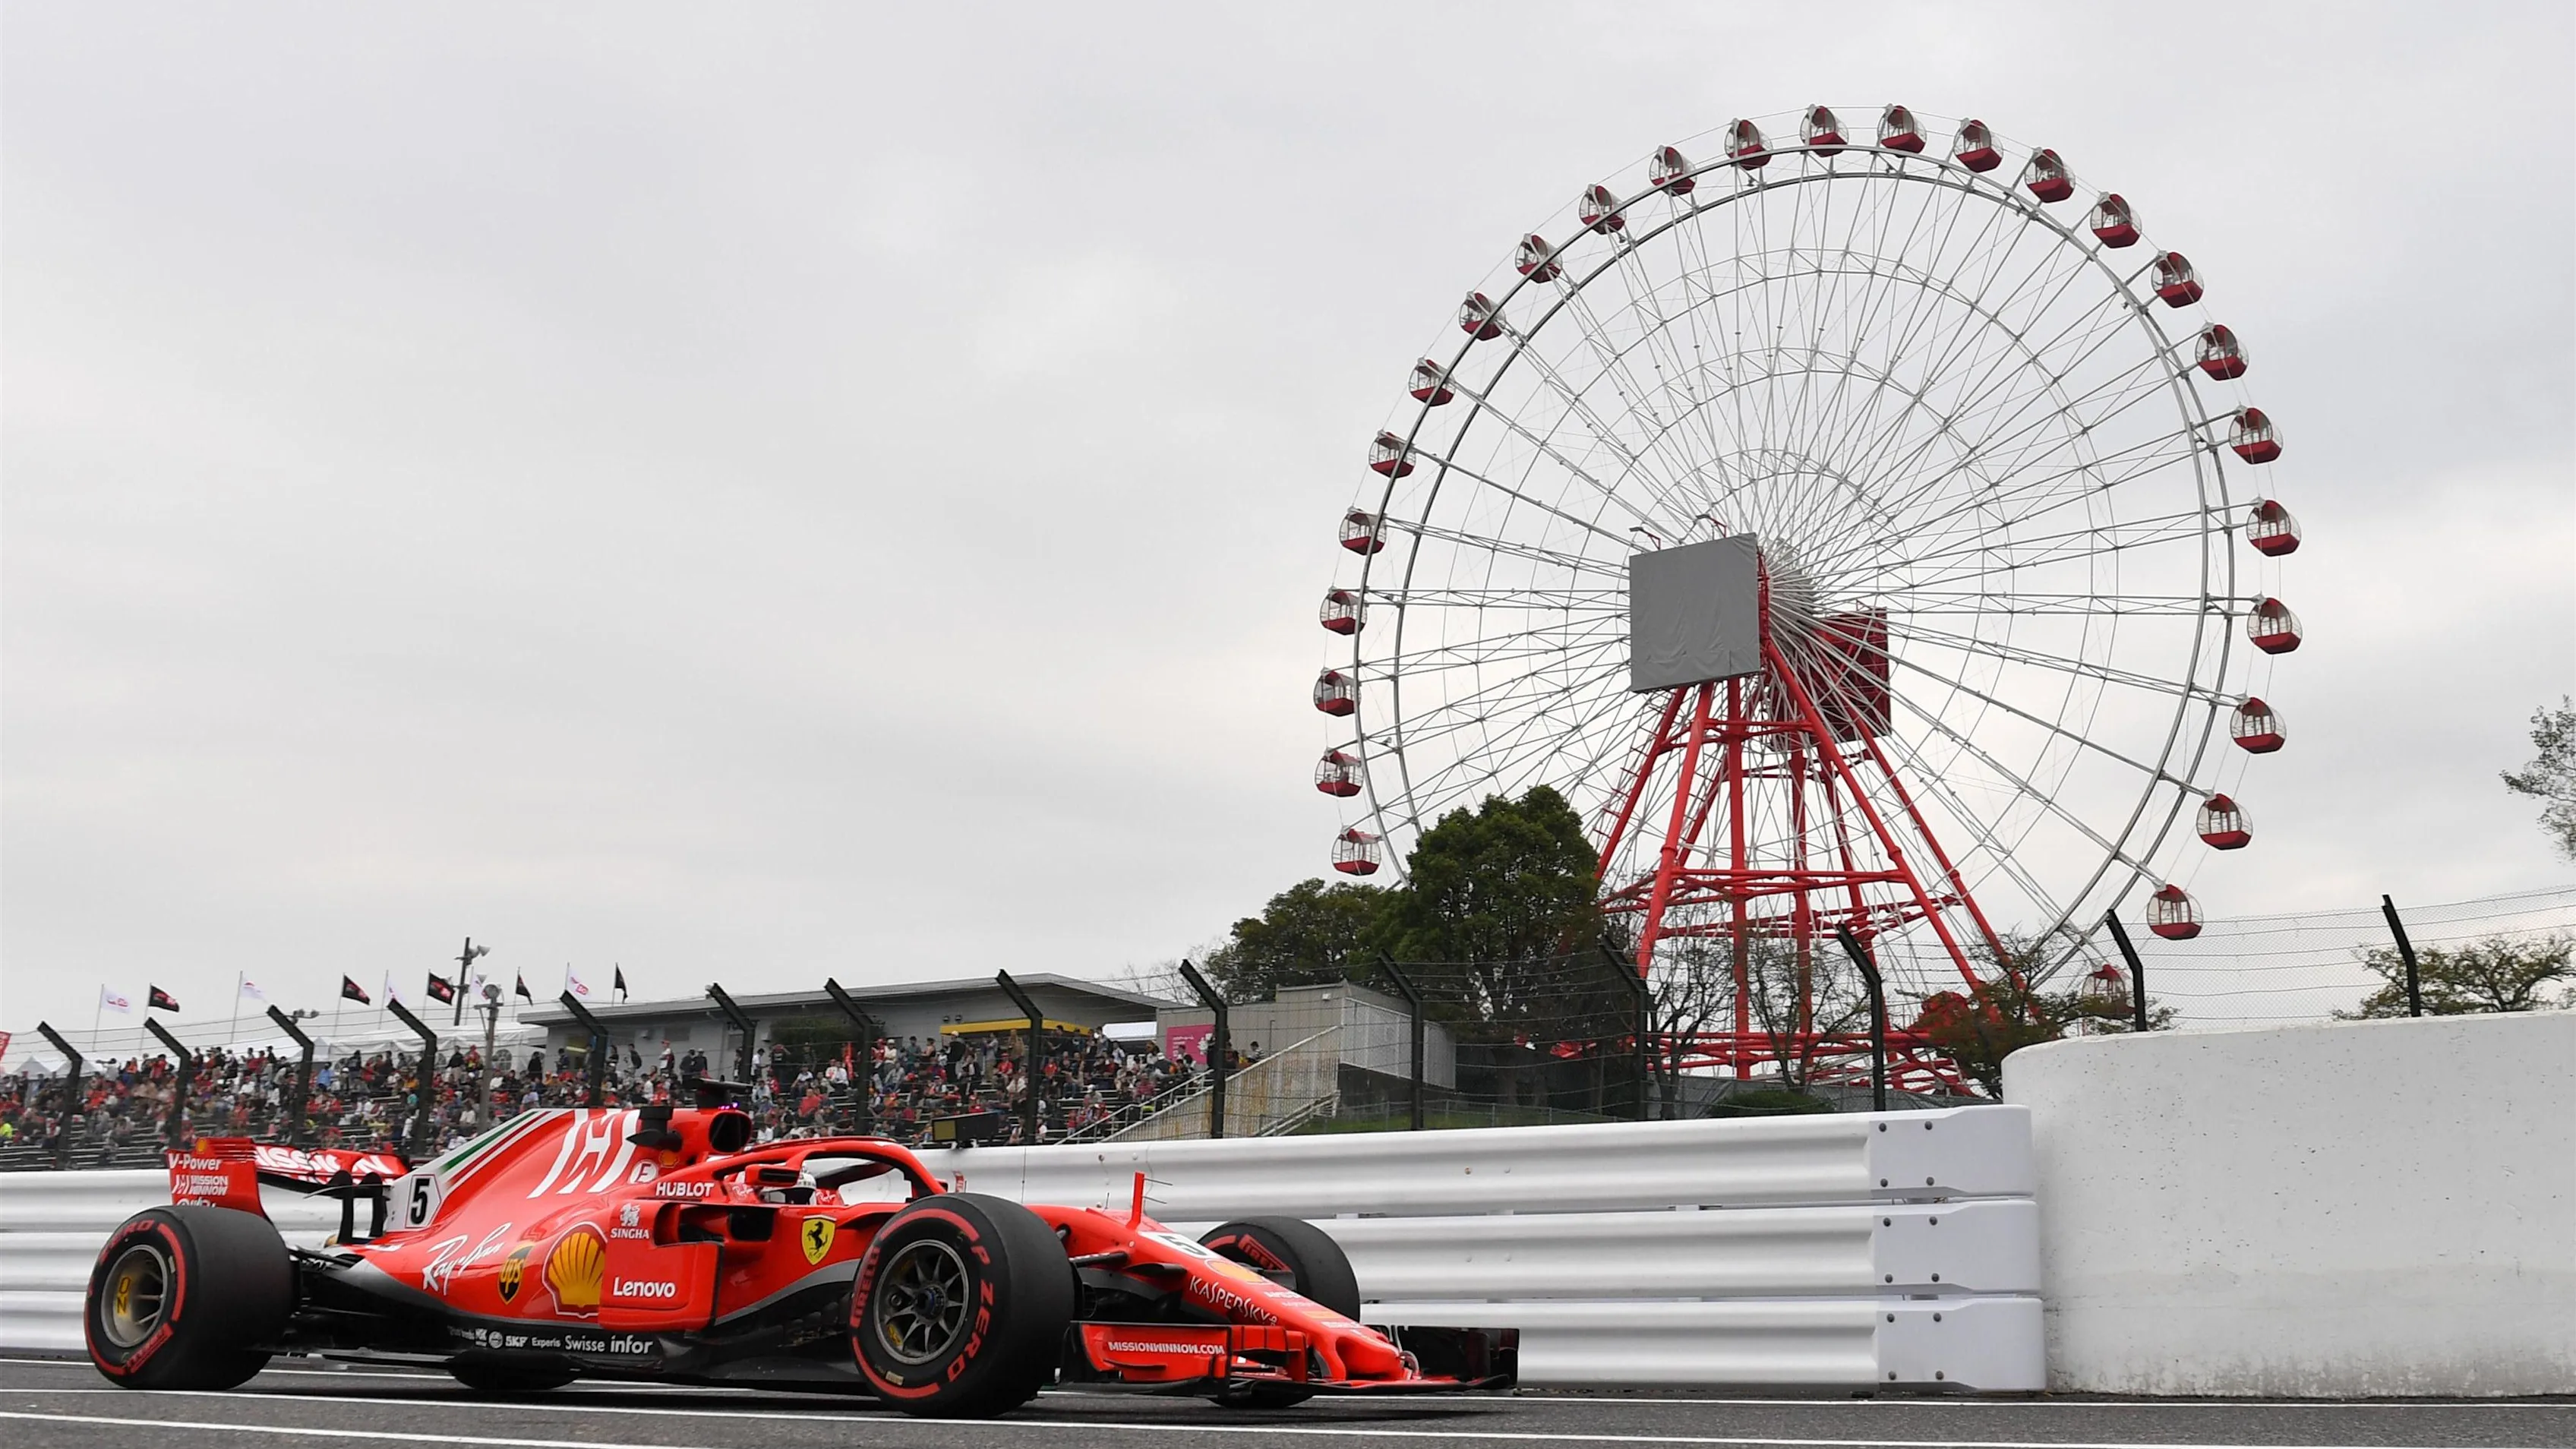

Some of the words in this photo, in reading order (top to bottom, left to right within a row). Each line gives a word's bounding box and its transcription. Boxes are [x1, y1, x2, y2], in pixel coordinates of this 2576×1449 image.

[169, 1153, 221, 1170] V-Power
[191, 1175, 229, 1185] MISSION
[655, 1182, 715, 1197] HUBLOT
[410, 1178, 428, 1224] 5
[610, 1227, 649, 1239] SINGHA
[971, 1245, 991, 1264] P
[500, 1258, 525, 1294] ups
[613, 1276, 675, 1298] Lenovo
[1189, 1275, 1269, 1321] KASPERSKY
[947, 1279, 994, 1382] ZERO
[505, 1335, 528, 1347] SKF
[532, 1337, 561, 1349] Experis
[565, 1335, 605, 1352] Swisse
[610, 1334, 654, 1354] infor
[1108, 1341, 1225, 1355] MISSIONWINNOW.COM
